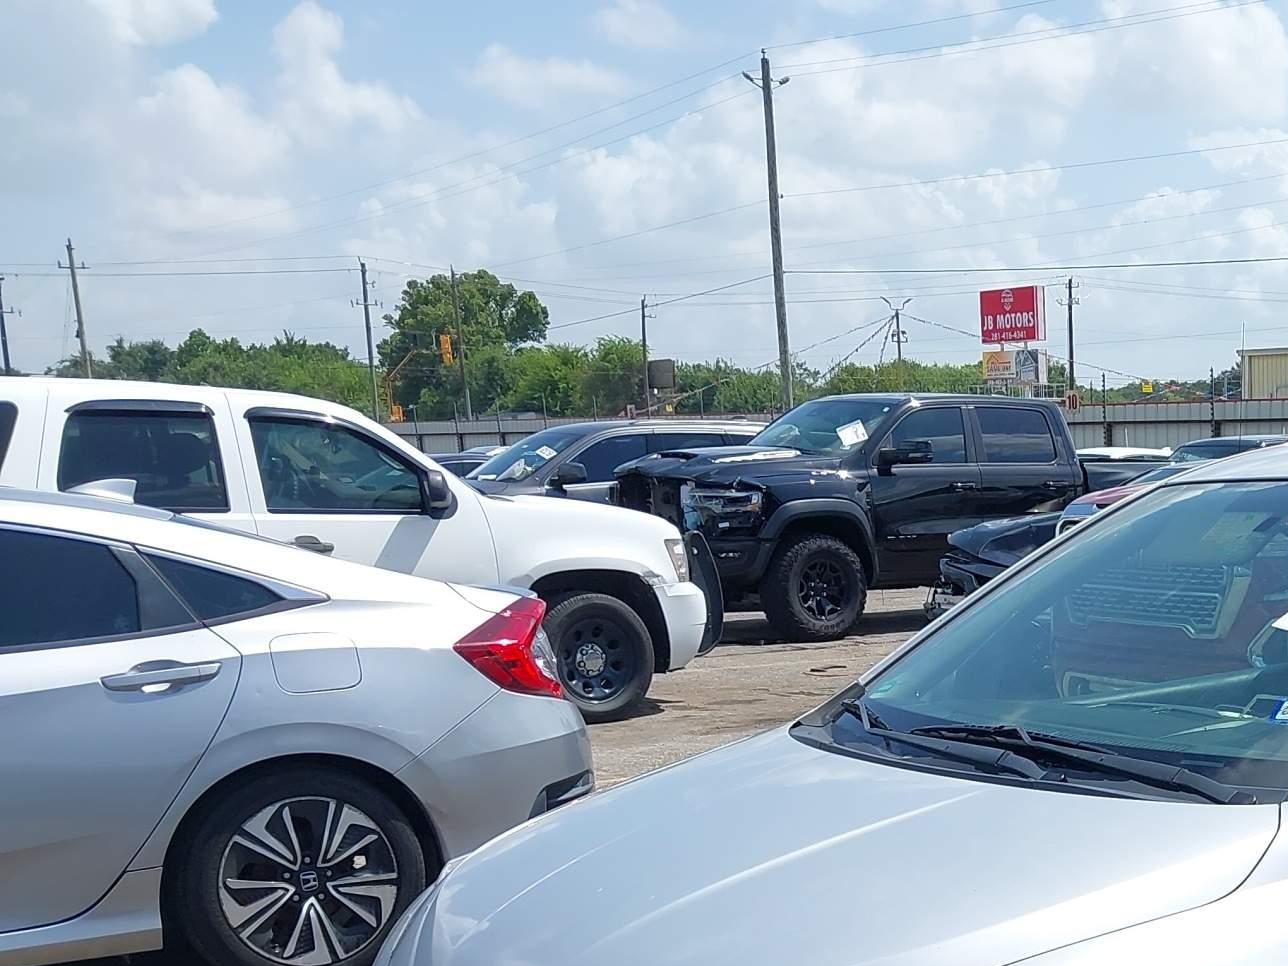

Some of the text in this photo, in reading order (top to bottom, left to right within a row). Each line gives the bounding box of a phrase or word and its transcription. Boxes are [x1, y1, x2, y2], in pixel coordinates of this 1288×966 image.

[983, 311, 1034, 331] JB MOTORS
[1067, 393, 1078, 410] 10
